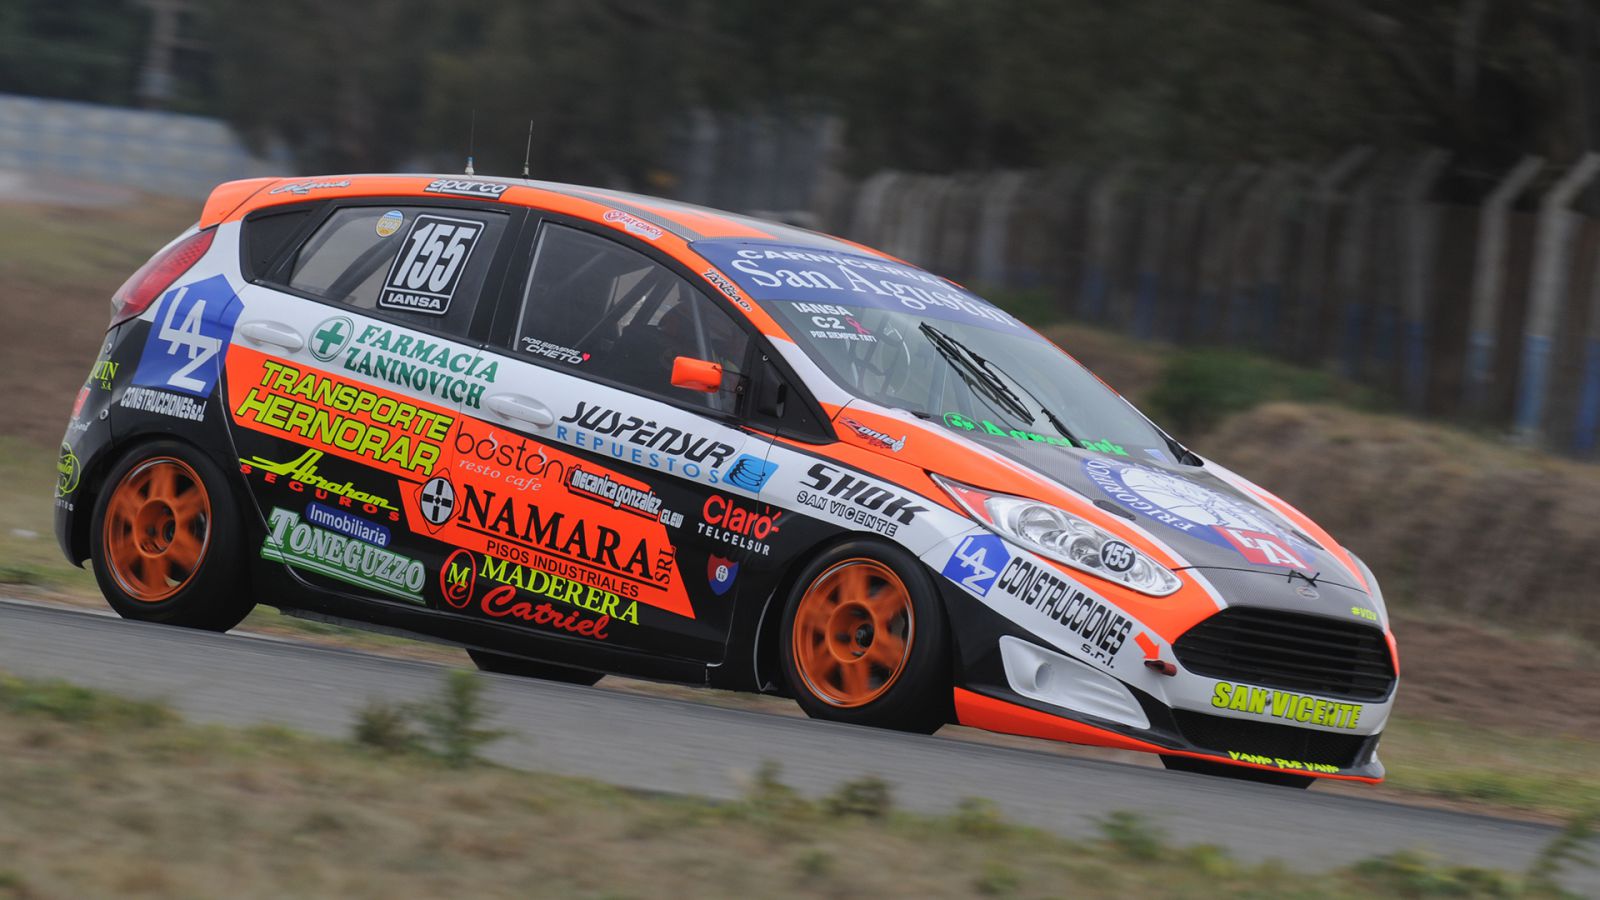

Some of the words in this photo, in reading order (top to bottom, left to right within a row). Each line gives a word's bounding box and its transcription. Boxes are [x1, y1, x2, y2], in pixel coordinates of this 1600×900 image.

[429, 180, 508, 193] sparco
[393, 222, 476, 292] 155
[731, 259, 843, 291] San
[388, 293, 441, 309] IANSA
[791, 302, 854, 317] IANSA
[811, 316, 846, 329] C2
[158, 287, 222, 392] LAZ
[356, 324, 499, 383] FARMACIA
[521, 336, 542, 346] POR
[541, 341, 581, 356] SIEMPRE
[525, 344, 583, 364] CHETO
[120, 387, 195, 420] CONSTRUCCIONES
[260, 360, 453, 442] TRANSPORTE
[344, 347, 486, 410] ZANINOVICH
[236, 388, 441, 477] HERNORAR
[455, 421, 565, 483] boston
[557, 425, 720, 485] REPUESTOS
[239, 448, 399, 511] Abraham
[240, 464, 400, 522] SEGUROS
[459, 457, 501, 479] resto
[505, 471, 542, 492] cafe
[799, 463, 930, 525] SHOK
[310, 504, 388, 546] Inmobiliaria
[458, 484, 656, 581] NAMARA
[655, 548, 675, 584] SRL
[697, 523, 771, 557] TELCELSUR
[703, 494, 773, 540] Claro
[796, 491, 828, 511] SAN
[829, 502, 899, 537] VICENTE
[265, 506, 426, 593] TONEGUZZO
[487, 540, 529, 564] PISOS
[533, 556, 640, 597] INDUSTRIALES
[956, 537, 997, 595] LAZ
[1104, 543, 1133, 569] 155
[479, 555, 641, 626] MADERERA
[480, 585, 612, 640] Catriel
[998, 556, 1133, 655] CONSTRUCCIONES
[1211, 681, 1271, 714] SAN
[1270, 690, 1363, 730] VICENTE
